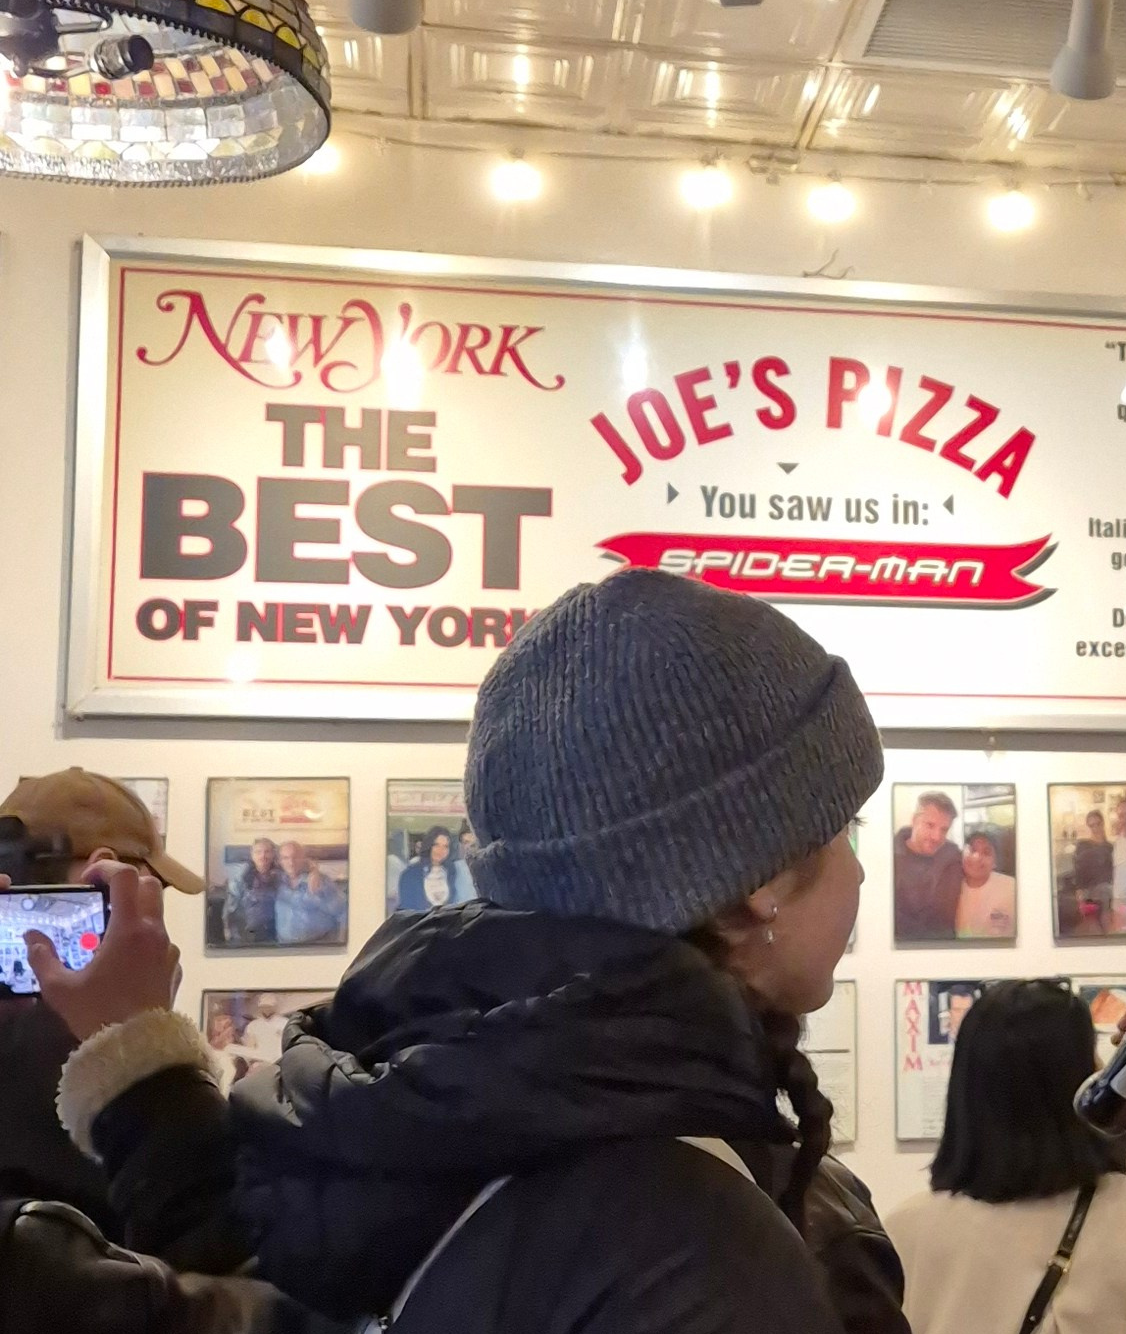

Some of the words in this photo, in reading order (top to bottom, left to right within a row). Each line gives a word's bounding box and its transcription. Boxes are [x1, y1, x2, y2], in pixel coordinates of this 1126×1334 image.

[136, 289, 365, 390] NEW
[320, 298, 566, 394] YORK
[265, 403, 437, 473] THE
[590, 356, 797, 486] JOE'S
[826, 356, 1036, 500] PIZZA
[139, 472, 552, 590] BEST
[700, 485, 756, 518] You
[768, 493, 831, 522] saw
[845, 495, 879, 524] us
[892, 494, 929, 526] in:
[657, 548, 985, 587] SPIDER-MAN
[135, 598, 219, 641] OF
[236, 601, 373, 645] NEW
[903, 980, 924, 1071] MAXIM
